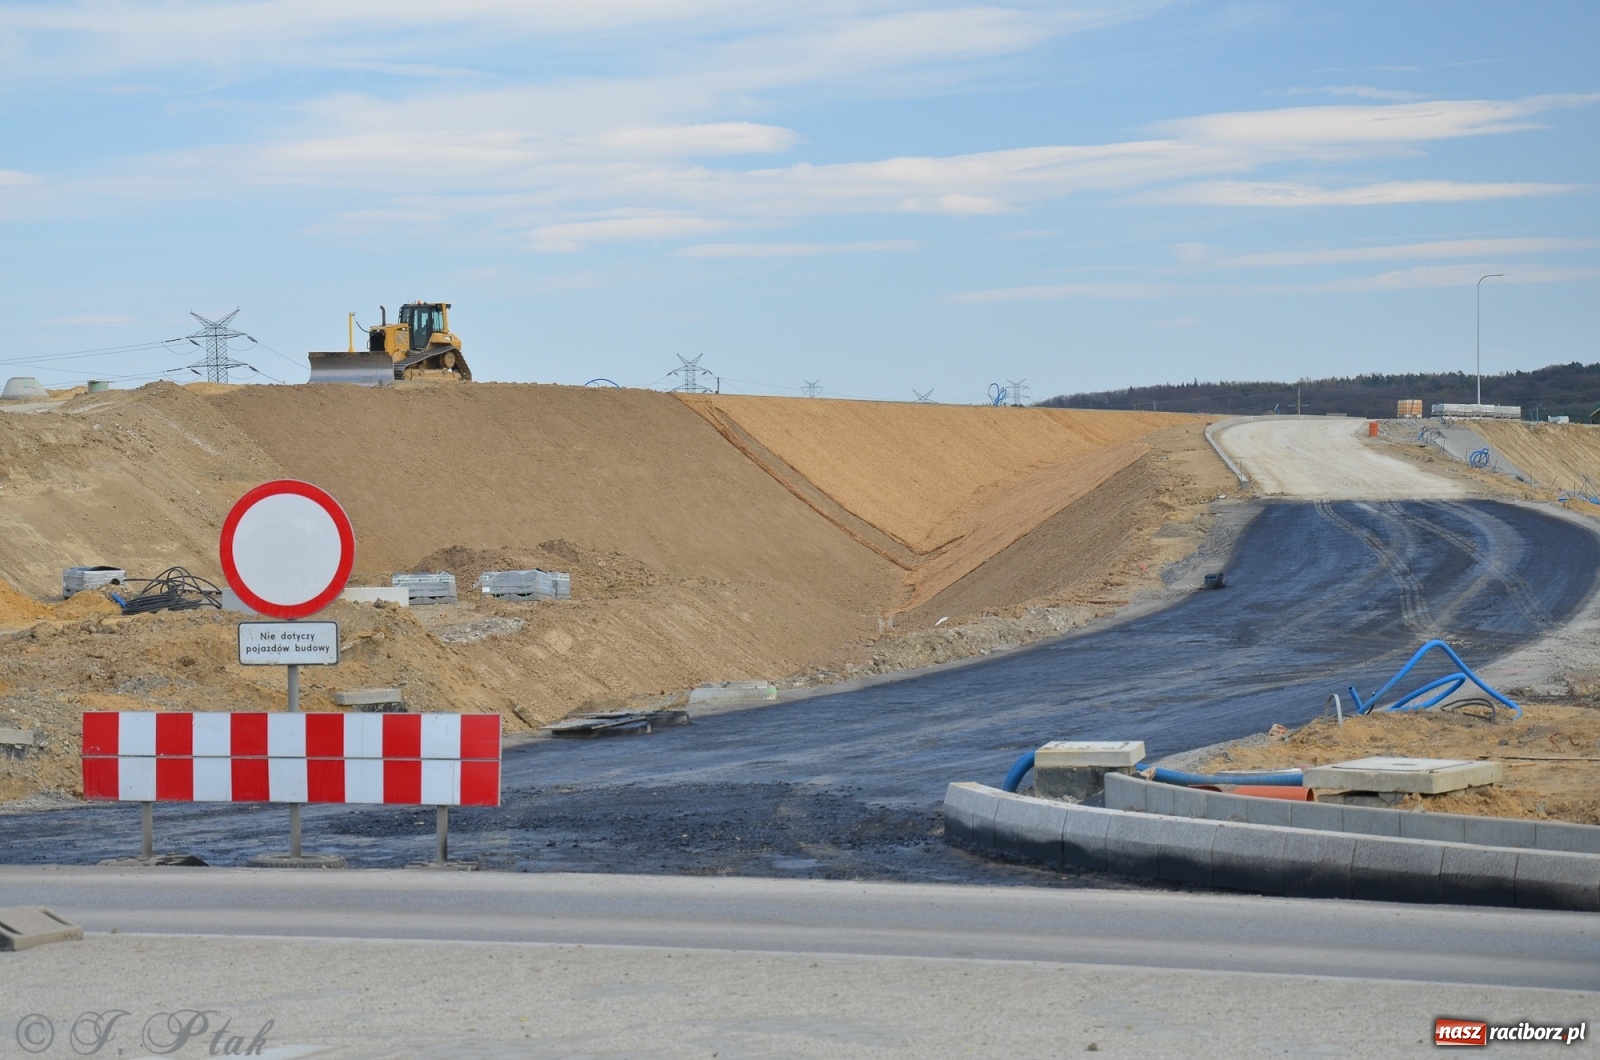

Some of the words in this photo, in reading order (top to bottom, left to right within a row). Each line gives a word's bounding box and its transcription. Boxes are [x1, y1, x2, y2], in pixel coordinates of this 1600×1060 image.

[260, 632, 275, 640] Nie
[280, 632, 315, 642] dotyczy
[246, 644, 290, 654] pojazdów
[294, 644, 330, 653] budowy
